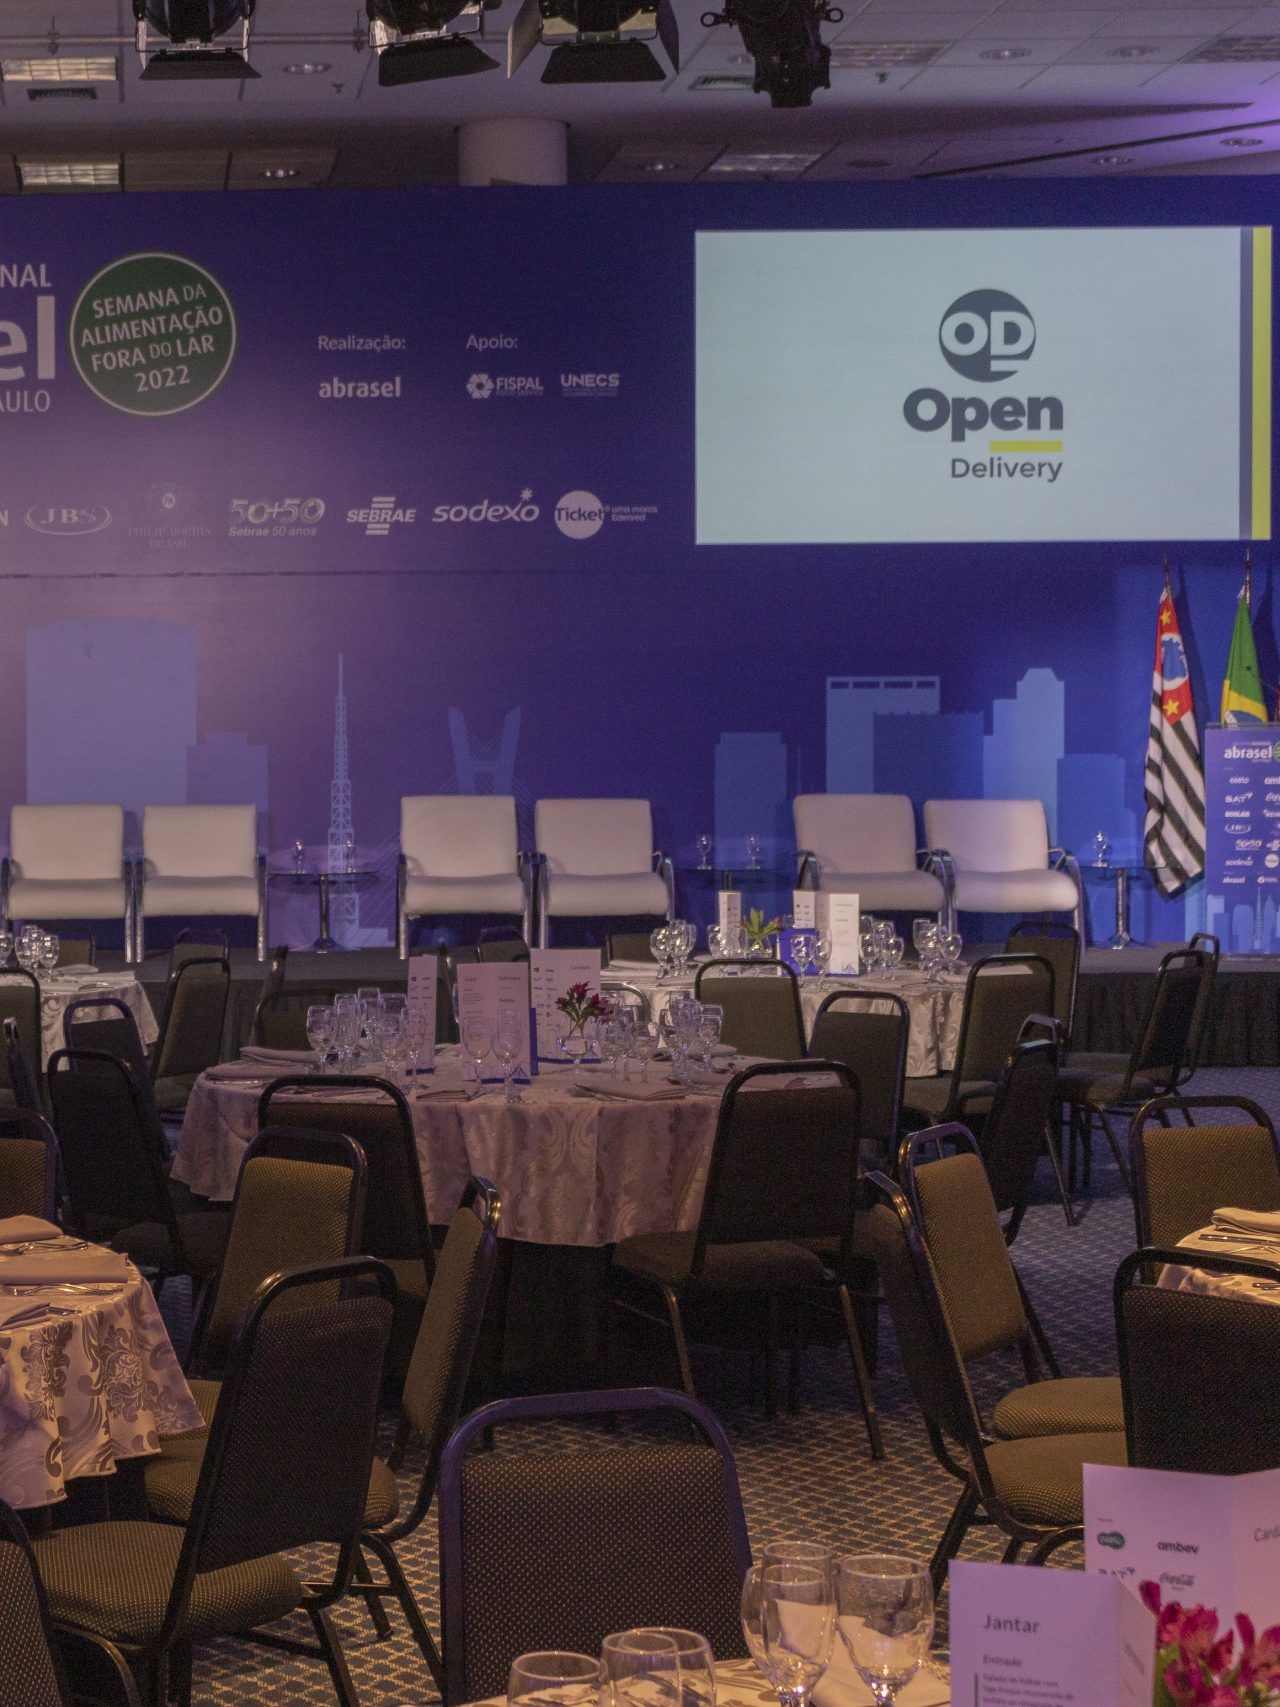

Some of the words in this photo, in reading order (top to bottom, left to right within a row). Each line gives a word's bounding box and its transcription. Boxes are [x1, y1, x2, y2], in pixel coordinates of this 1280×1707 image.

[92, 287, 180, 319] SEMANA
[183, 283, 207, 302] DA
[81, 305, 224, 348] ALIMENTAÇÃO
[318, 334, 406, 353] Realização:
[466, 333, 518, 352] Apoio:
[91, 346, 147, 373] FORA
[149, 341, 172, 359] DO
[175, 334, 215, 358] LAR
[134, 364, 191, 393] 2022
[318, 375, 401, 399] abrasel
[496, 376, 544, 391] FISPAL
[561, 373, 620, 387] UNECS
[902, 387, 1064, 442] Open
[950, 456, 1064, 484] Delivery
[39, 507, 99, 524] JBS
[346, 509, 417, 523] SEBRAE
[431, 499, 540, 523] sodexo
[554, 507, 605, 522] Ticket
[228, 526, 269, 537] Sebrae
[1223, 745, 1273, 759] abrasel
[1157, 1542, 1200, 1555] ambev
[982, 1613, 1041, 1635] Jantar
